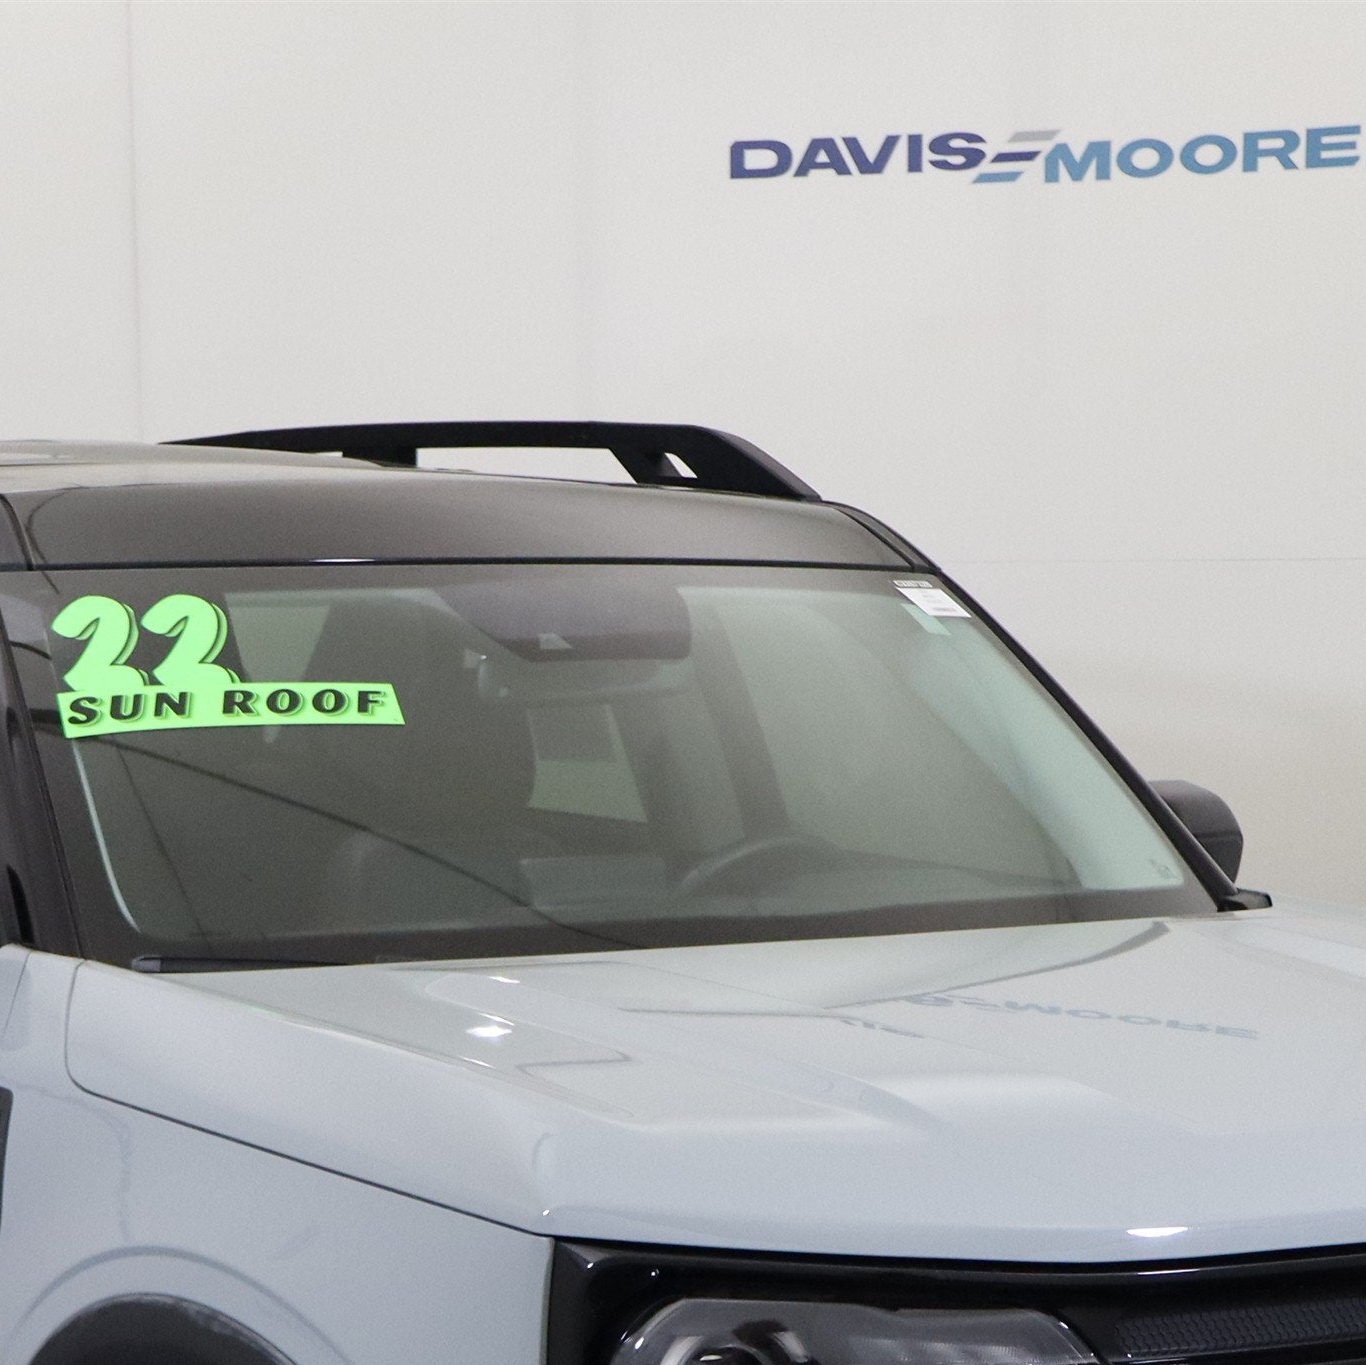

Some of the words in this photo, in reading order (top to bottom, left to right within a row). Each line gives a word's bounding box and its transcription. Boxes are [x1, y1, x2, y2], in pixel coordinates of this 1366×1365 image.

[729, 130, 987, 180] DAVIS
[1044, 124, 1362, 183] MOORE
[51, 594, 241, 692] 22
[68, 690, 192, 726] SUN
[221, 688, 388, 719] ROOF
